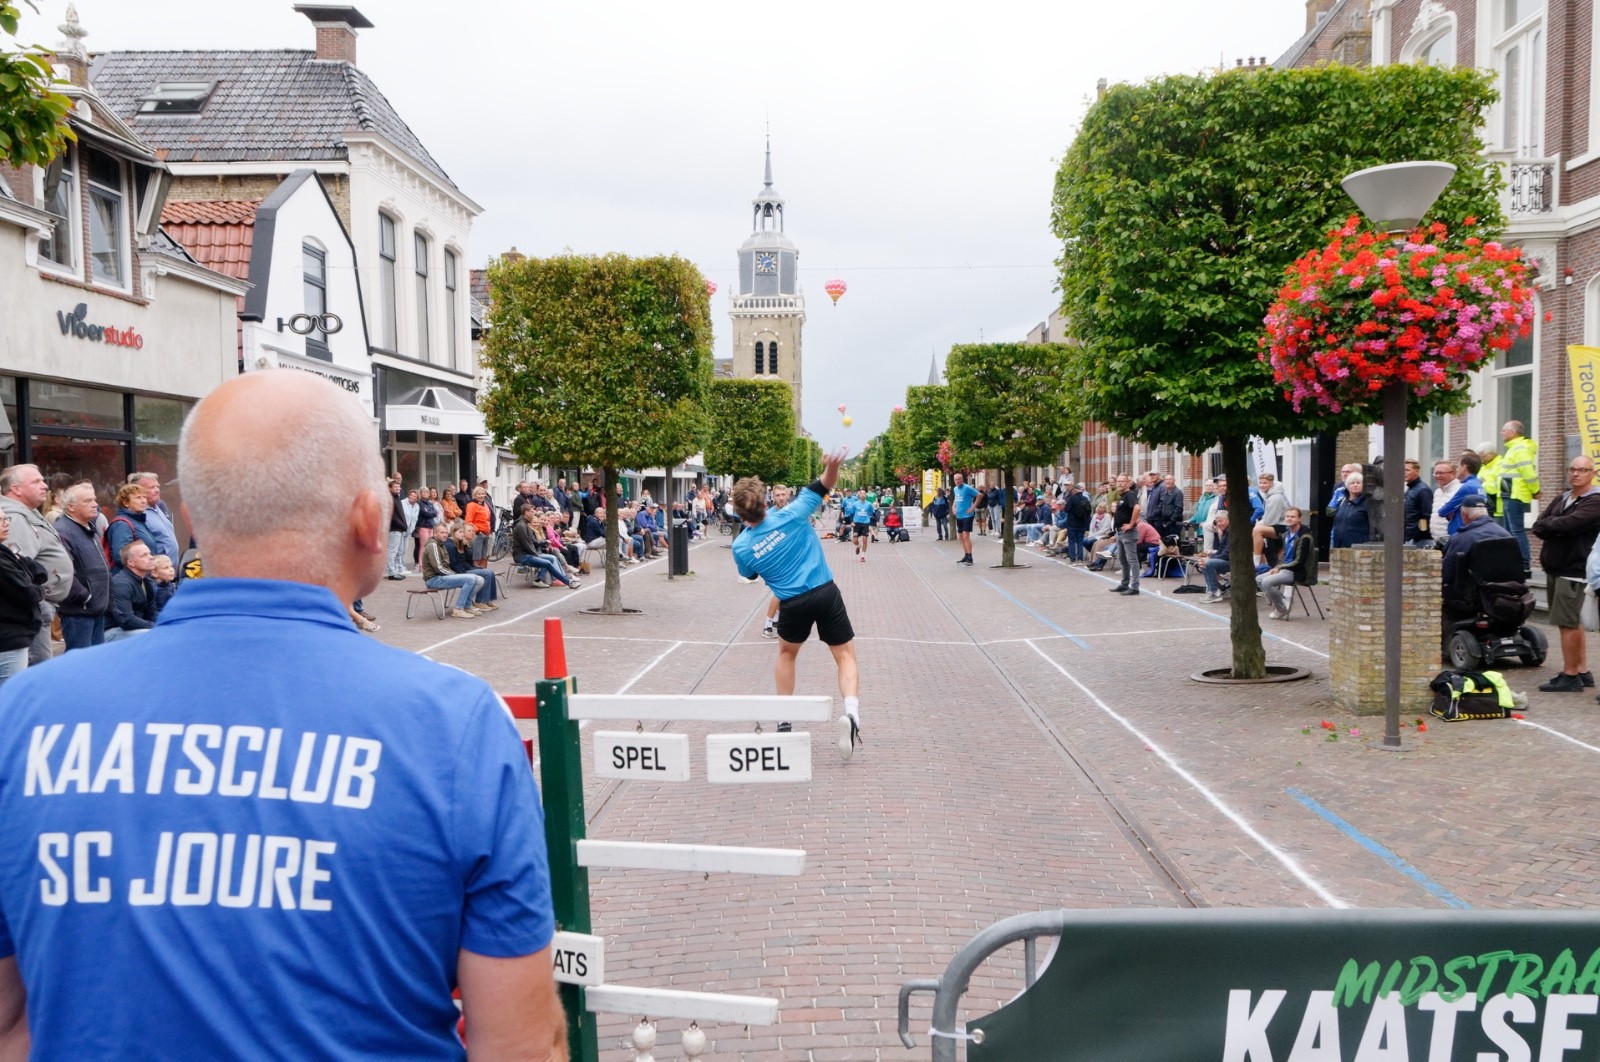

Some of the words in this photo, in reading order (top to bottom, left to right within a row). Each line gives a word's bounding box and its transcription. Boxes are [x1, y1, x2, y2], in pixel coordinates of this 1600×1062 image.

[24, 722, 382, 809] KAATSCLUB
[612, 745, 666, 771] SPEL
[729, 746, 790, 772] SPEL
[38, 831, 112, 906] SC
[128, 832, 336, 911] JOURE
